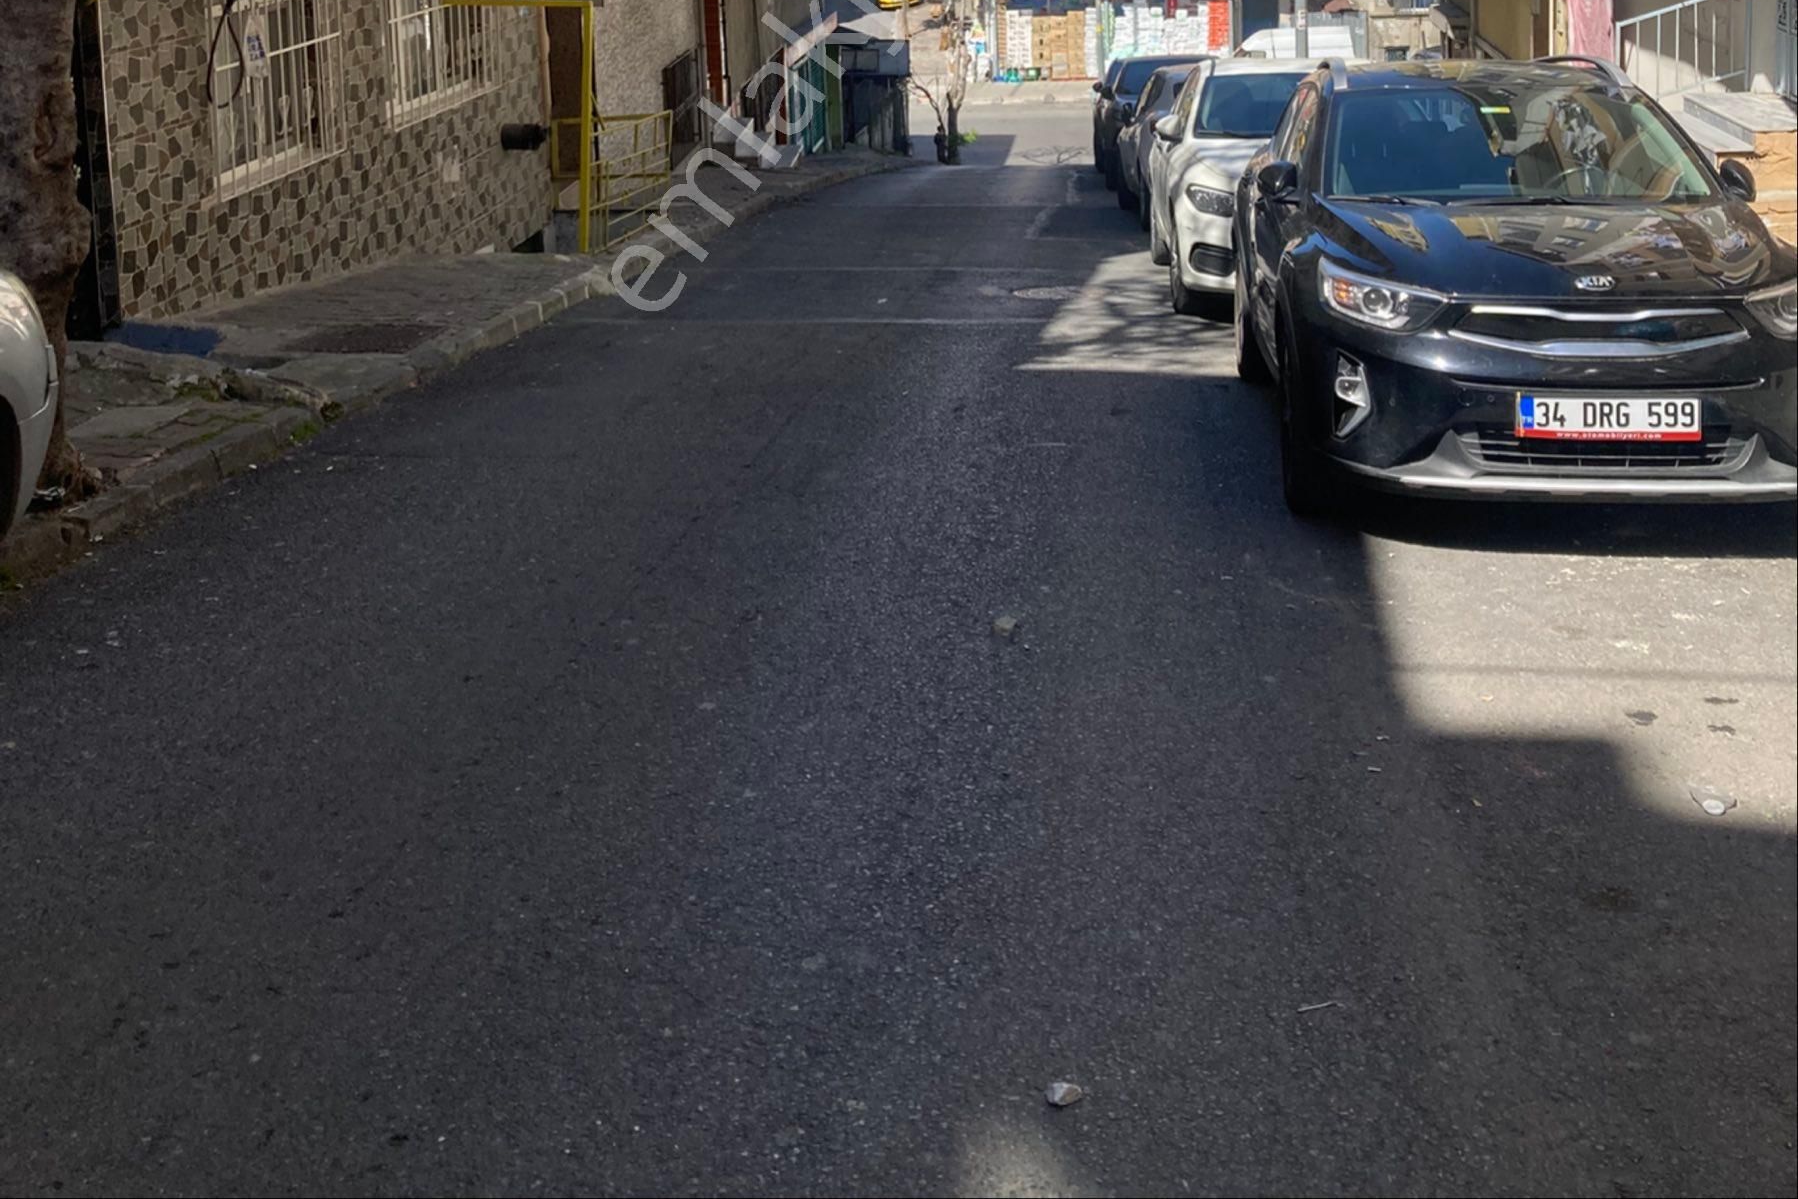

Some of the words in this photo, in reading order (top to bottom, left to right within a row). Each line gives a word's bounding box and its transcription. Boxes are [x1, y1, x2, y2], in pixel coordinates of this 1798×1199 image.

[1535, 401, 1567, 428] 34
[1582, 401, 1630, 428] DRG
[1648, 401, 1695, 428] 599
